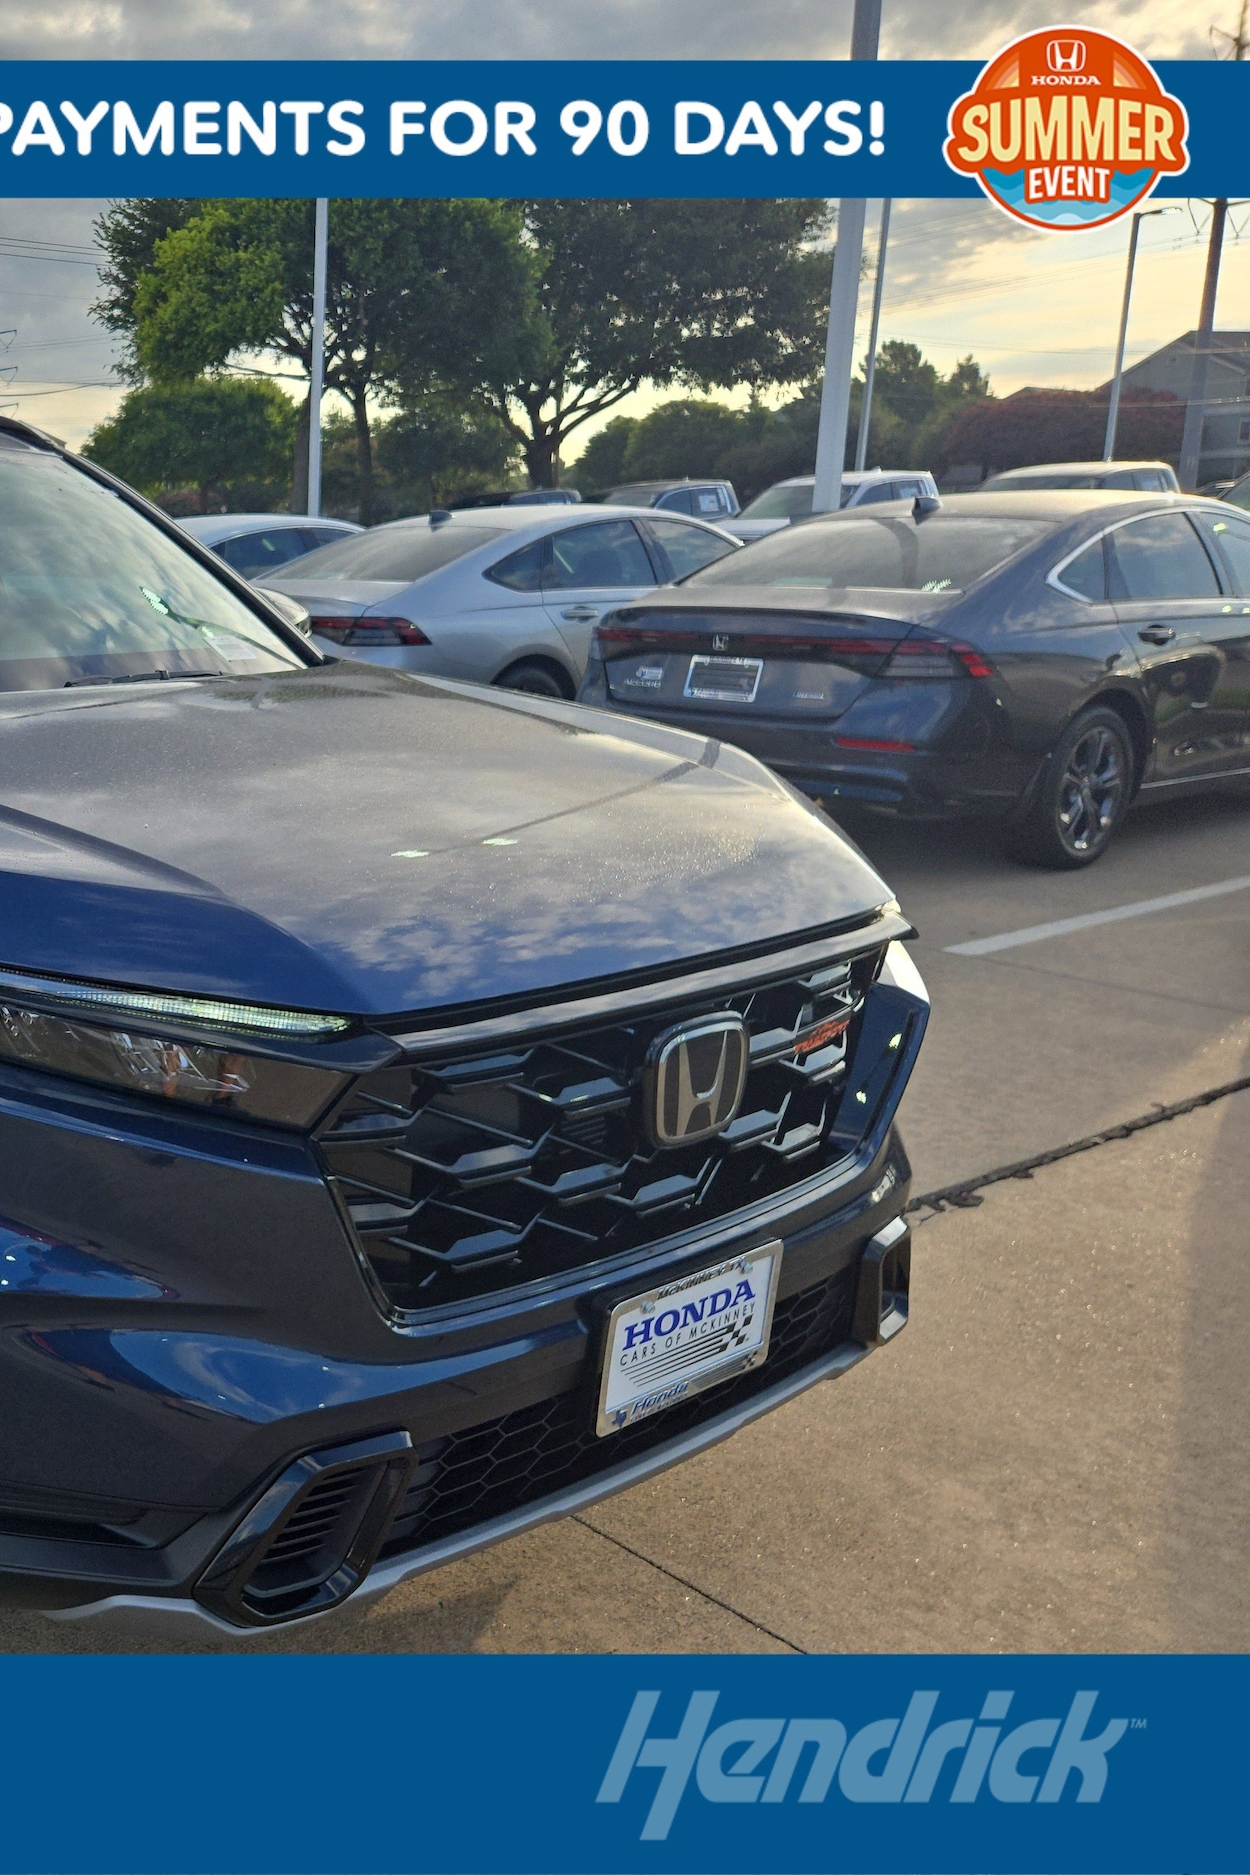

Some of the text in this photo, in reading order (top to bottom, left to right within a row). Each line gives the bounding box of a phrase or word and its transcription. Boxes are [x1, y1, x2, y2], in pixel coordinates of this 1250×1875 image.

[620, 1301, 756, 1366] CARS OF MCKINNEY
[622, 1279, 756, 1351] HONDA
[629, 1380, 689, 1415] Honda
